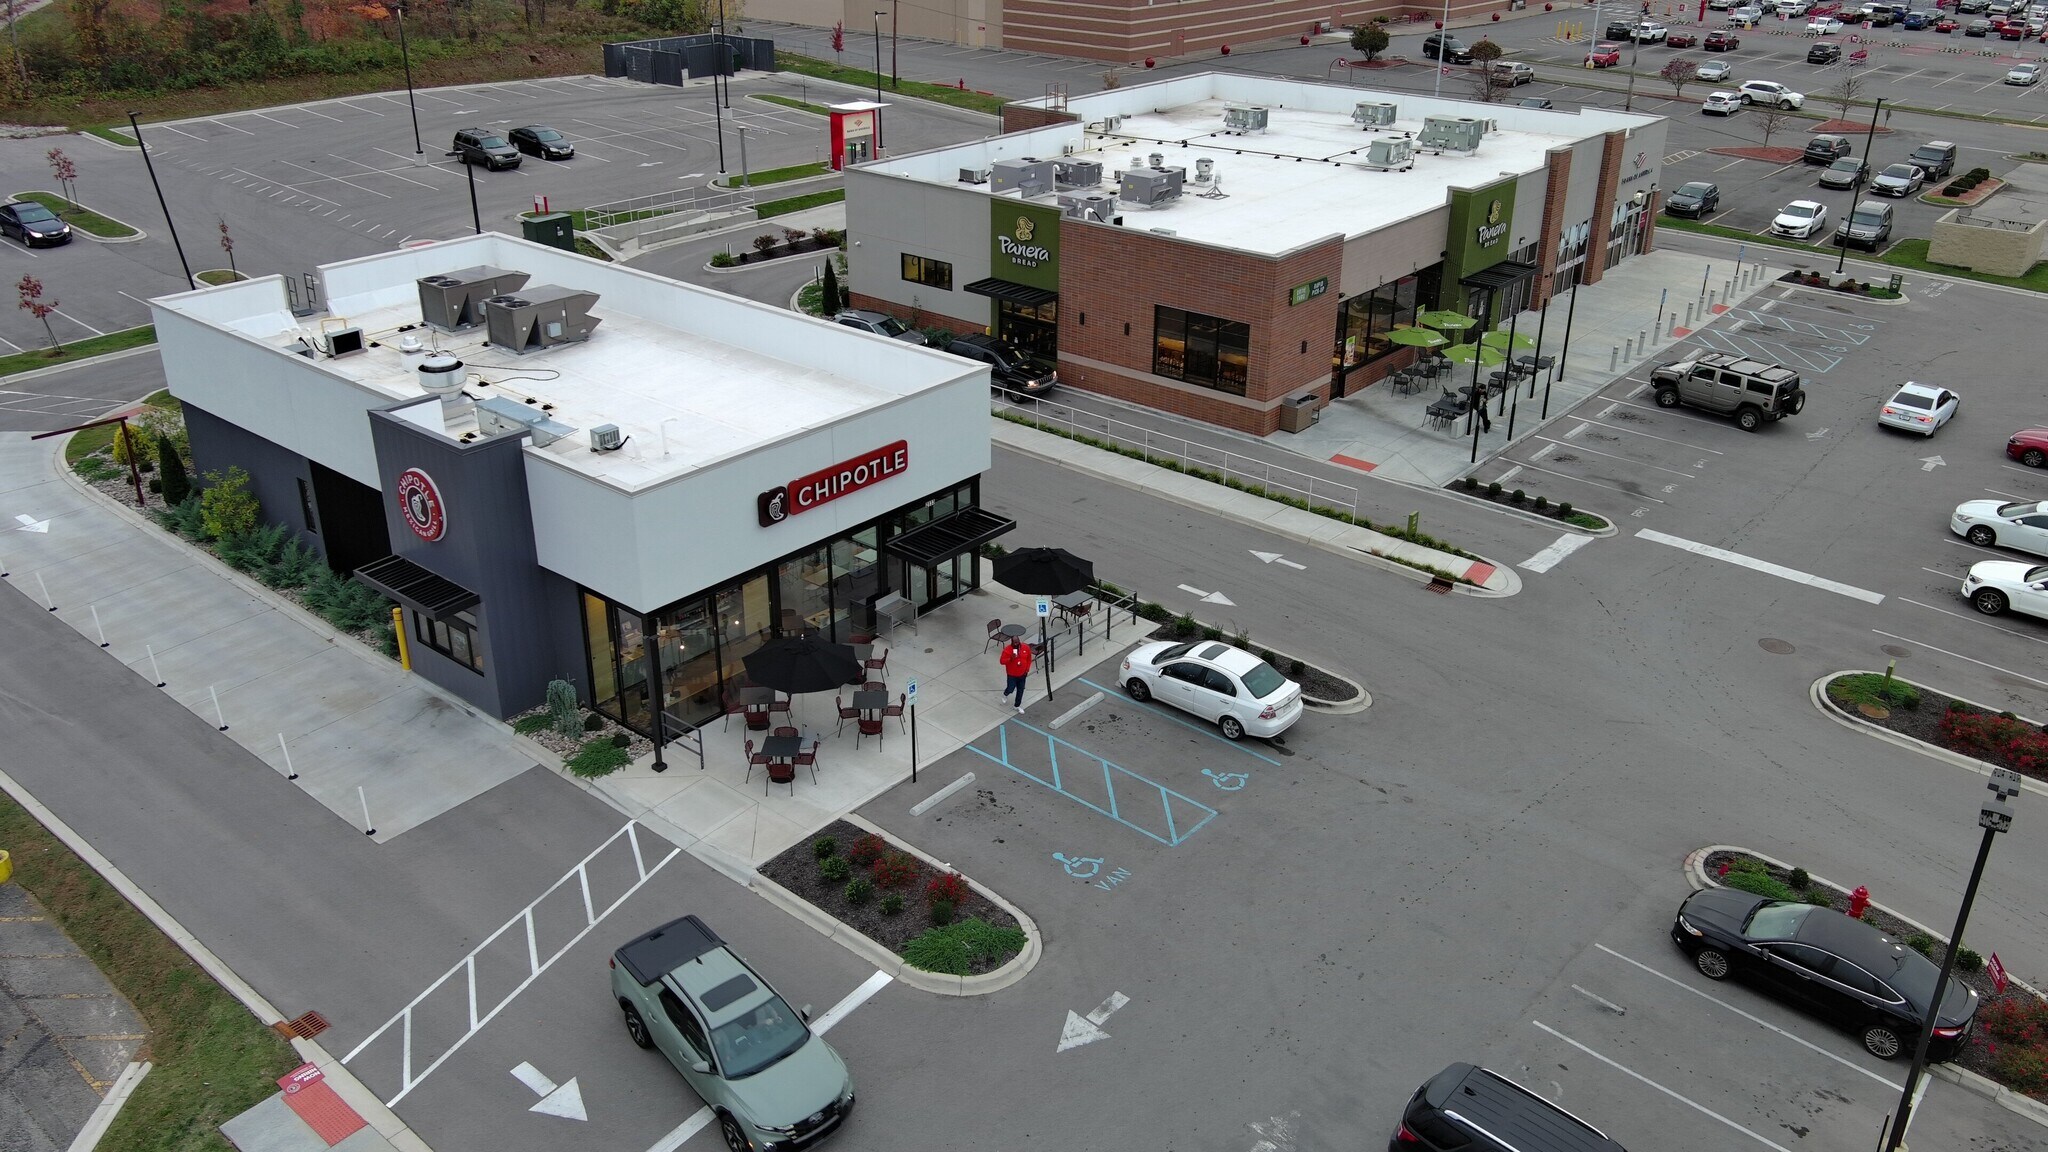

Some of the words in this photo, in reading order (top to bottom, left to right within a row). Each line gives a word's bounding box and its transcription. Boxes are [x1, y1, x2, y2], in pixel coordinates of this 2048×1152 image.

[1479, 222, 1507, 244] Panera
[997, 235, 1049, 261] Panera
[1012, 257, 1037, 267] BREAD
[799, 449, 905, 506] CHIPOTLE
[399, 475, 435, 508] CHIPOTLE
[403, 506, 427, 537] MEXICAN
[1094, 867, 1132, 891] VAN
[293, 1067, 318, 1081] HIRING
[303, 1070, 321, 1082] NOW
